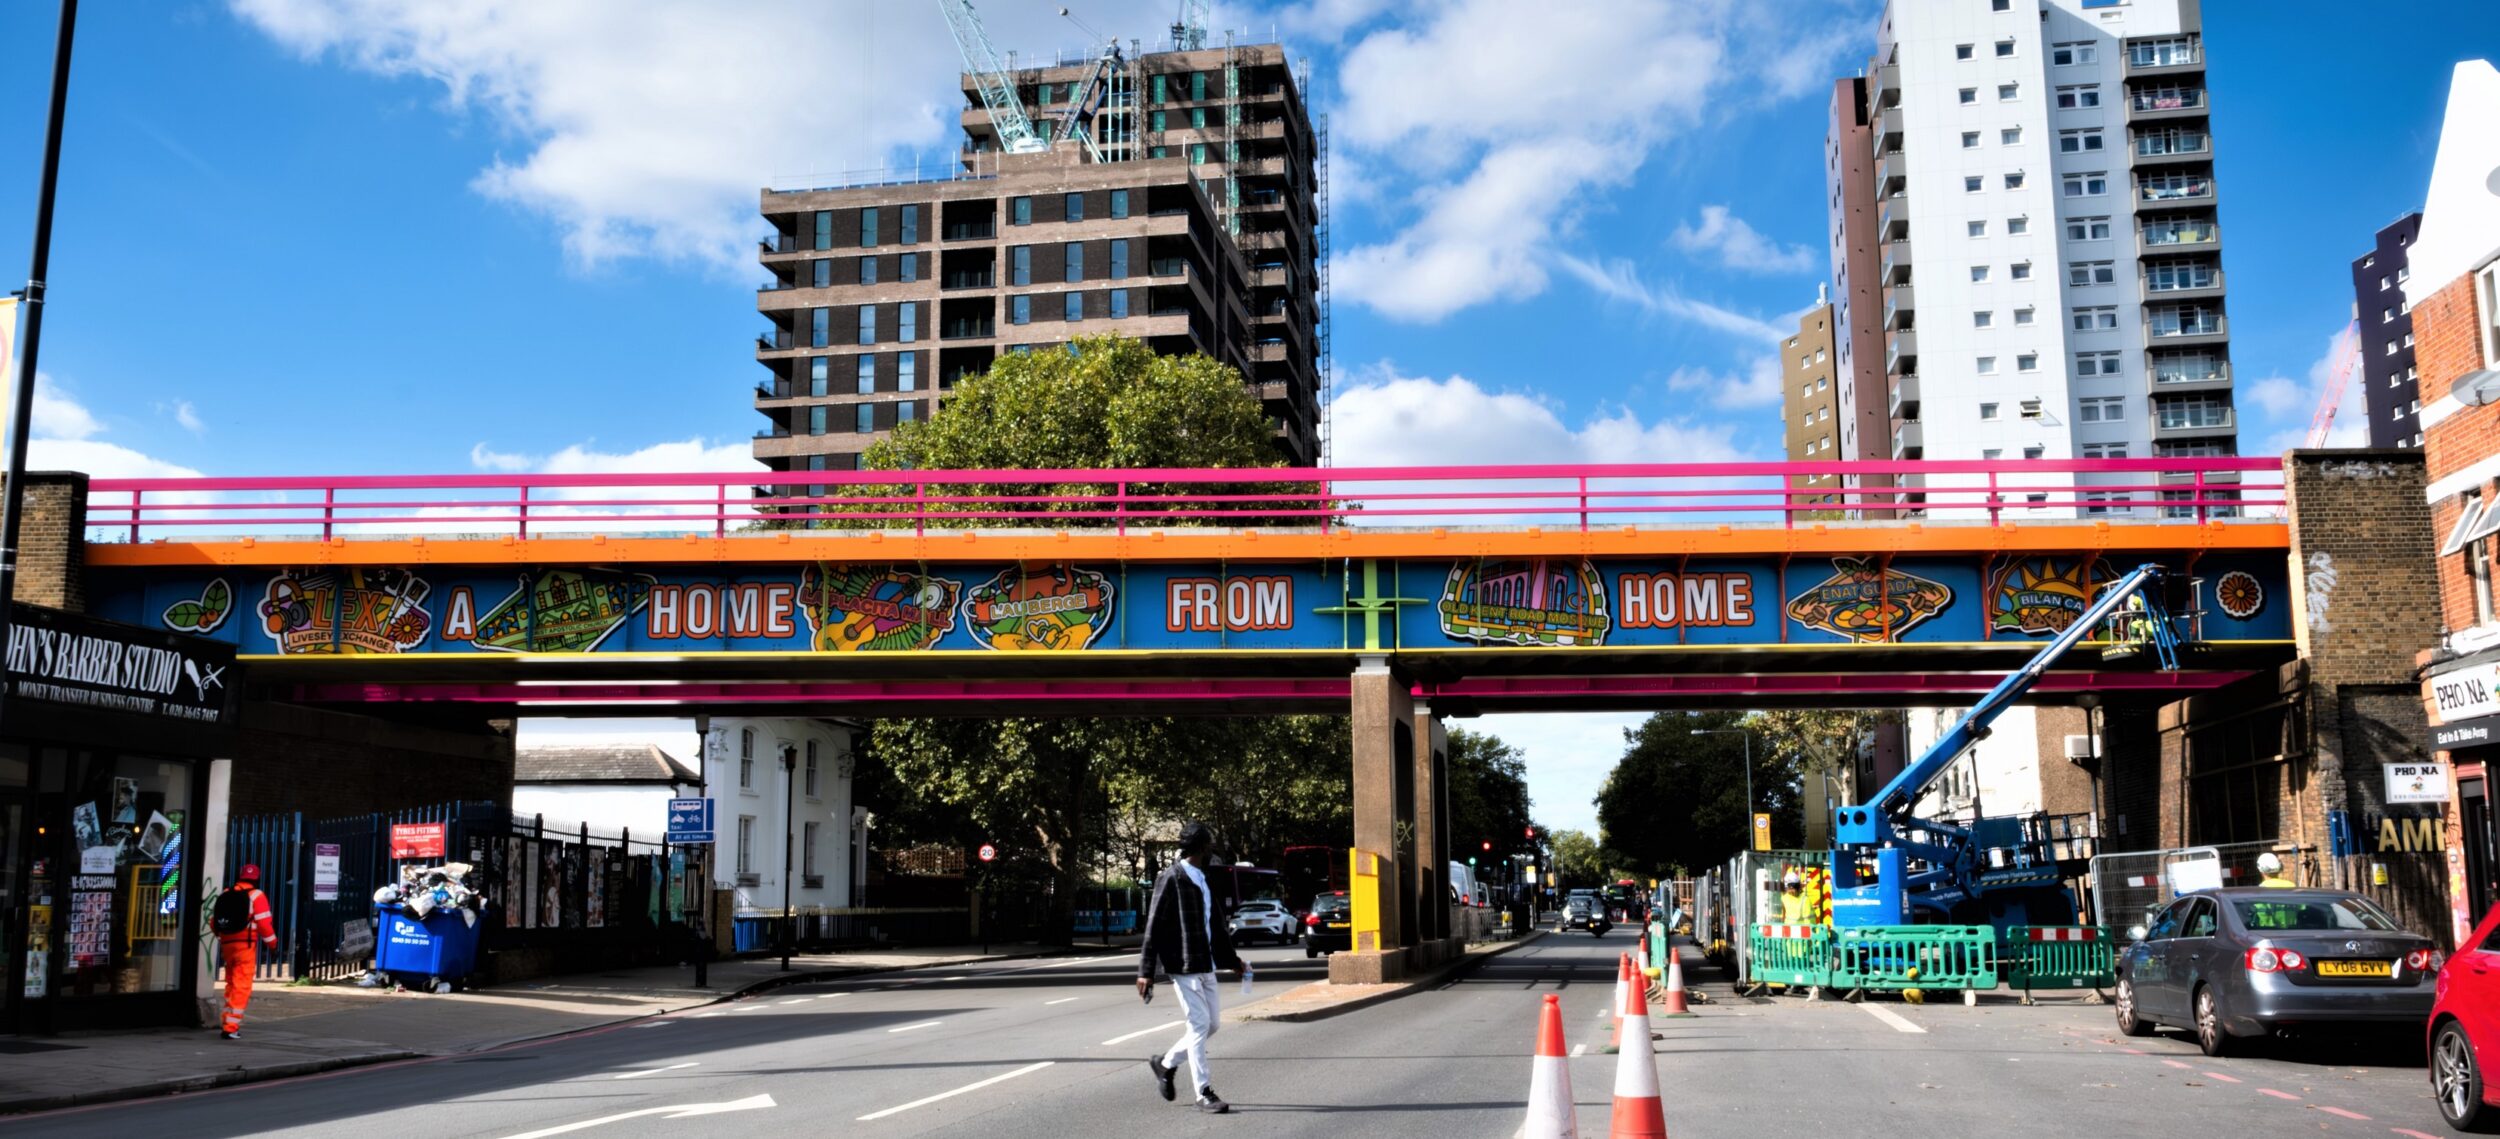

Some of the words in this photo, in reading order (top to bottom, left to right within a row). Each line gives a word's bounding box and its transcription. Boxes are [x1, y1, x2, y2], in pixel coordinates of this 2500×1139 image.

[829, 595, 899, 619] PLACITA
[990, 594, 1087, 620] L'AUBERGE
[1169, 578, 1290, 630] FROM
[1622, 574, 1753, 626] HOME
[1821, 586, 1859, 600] ENAT
[2021, 594, 2061, 606] BILAN
[313, 588, 383, 632] LEX
[443, 588, 476, 638] A
[650, 585, 793, 637] HOME
[1442, 601, 1468, 614] OLD
[1470, 604, 1506, 618] KENT
[1509, 608, 1546, 622] ROAD
[1548, 611, 1608, 628] MOSQUE
[292, 631, 332, 645] LIVESEY
[340, 632, 390, 650] XCHANGE
[53, 632, 123, 687] BARBER
[121, 644, 181, 695] STUDIO
[17, 681, 49, 699] MONEY
[50, 684, 89, 704] TRANSFER
[89, 690, 126, 708] BUSINESS
[126, 696, 155, 712] CENTRE
[2436, 683, 2465, 710] PHO
[2465, 678, 2489, 704] NA
[2394, 766, 2417, 776] PHO
[2421, 766, 2439, 775] NA
[396, 827, 416, 835] TYRES
[416, 826, 441, 834] FITTING
